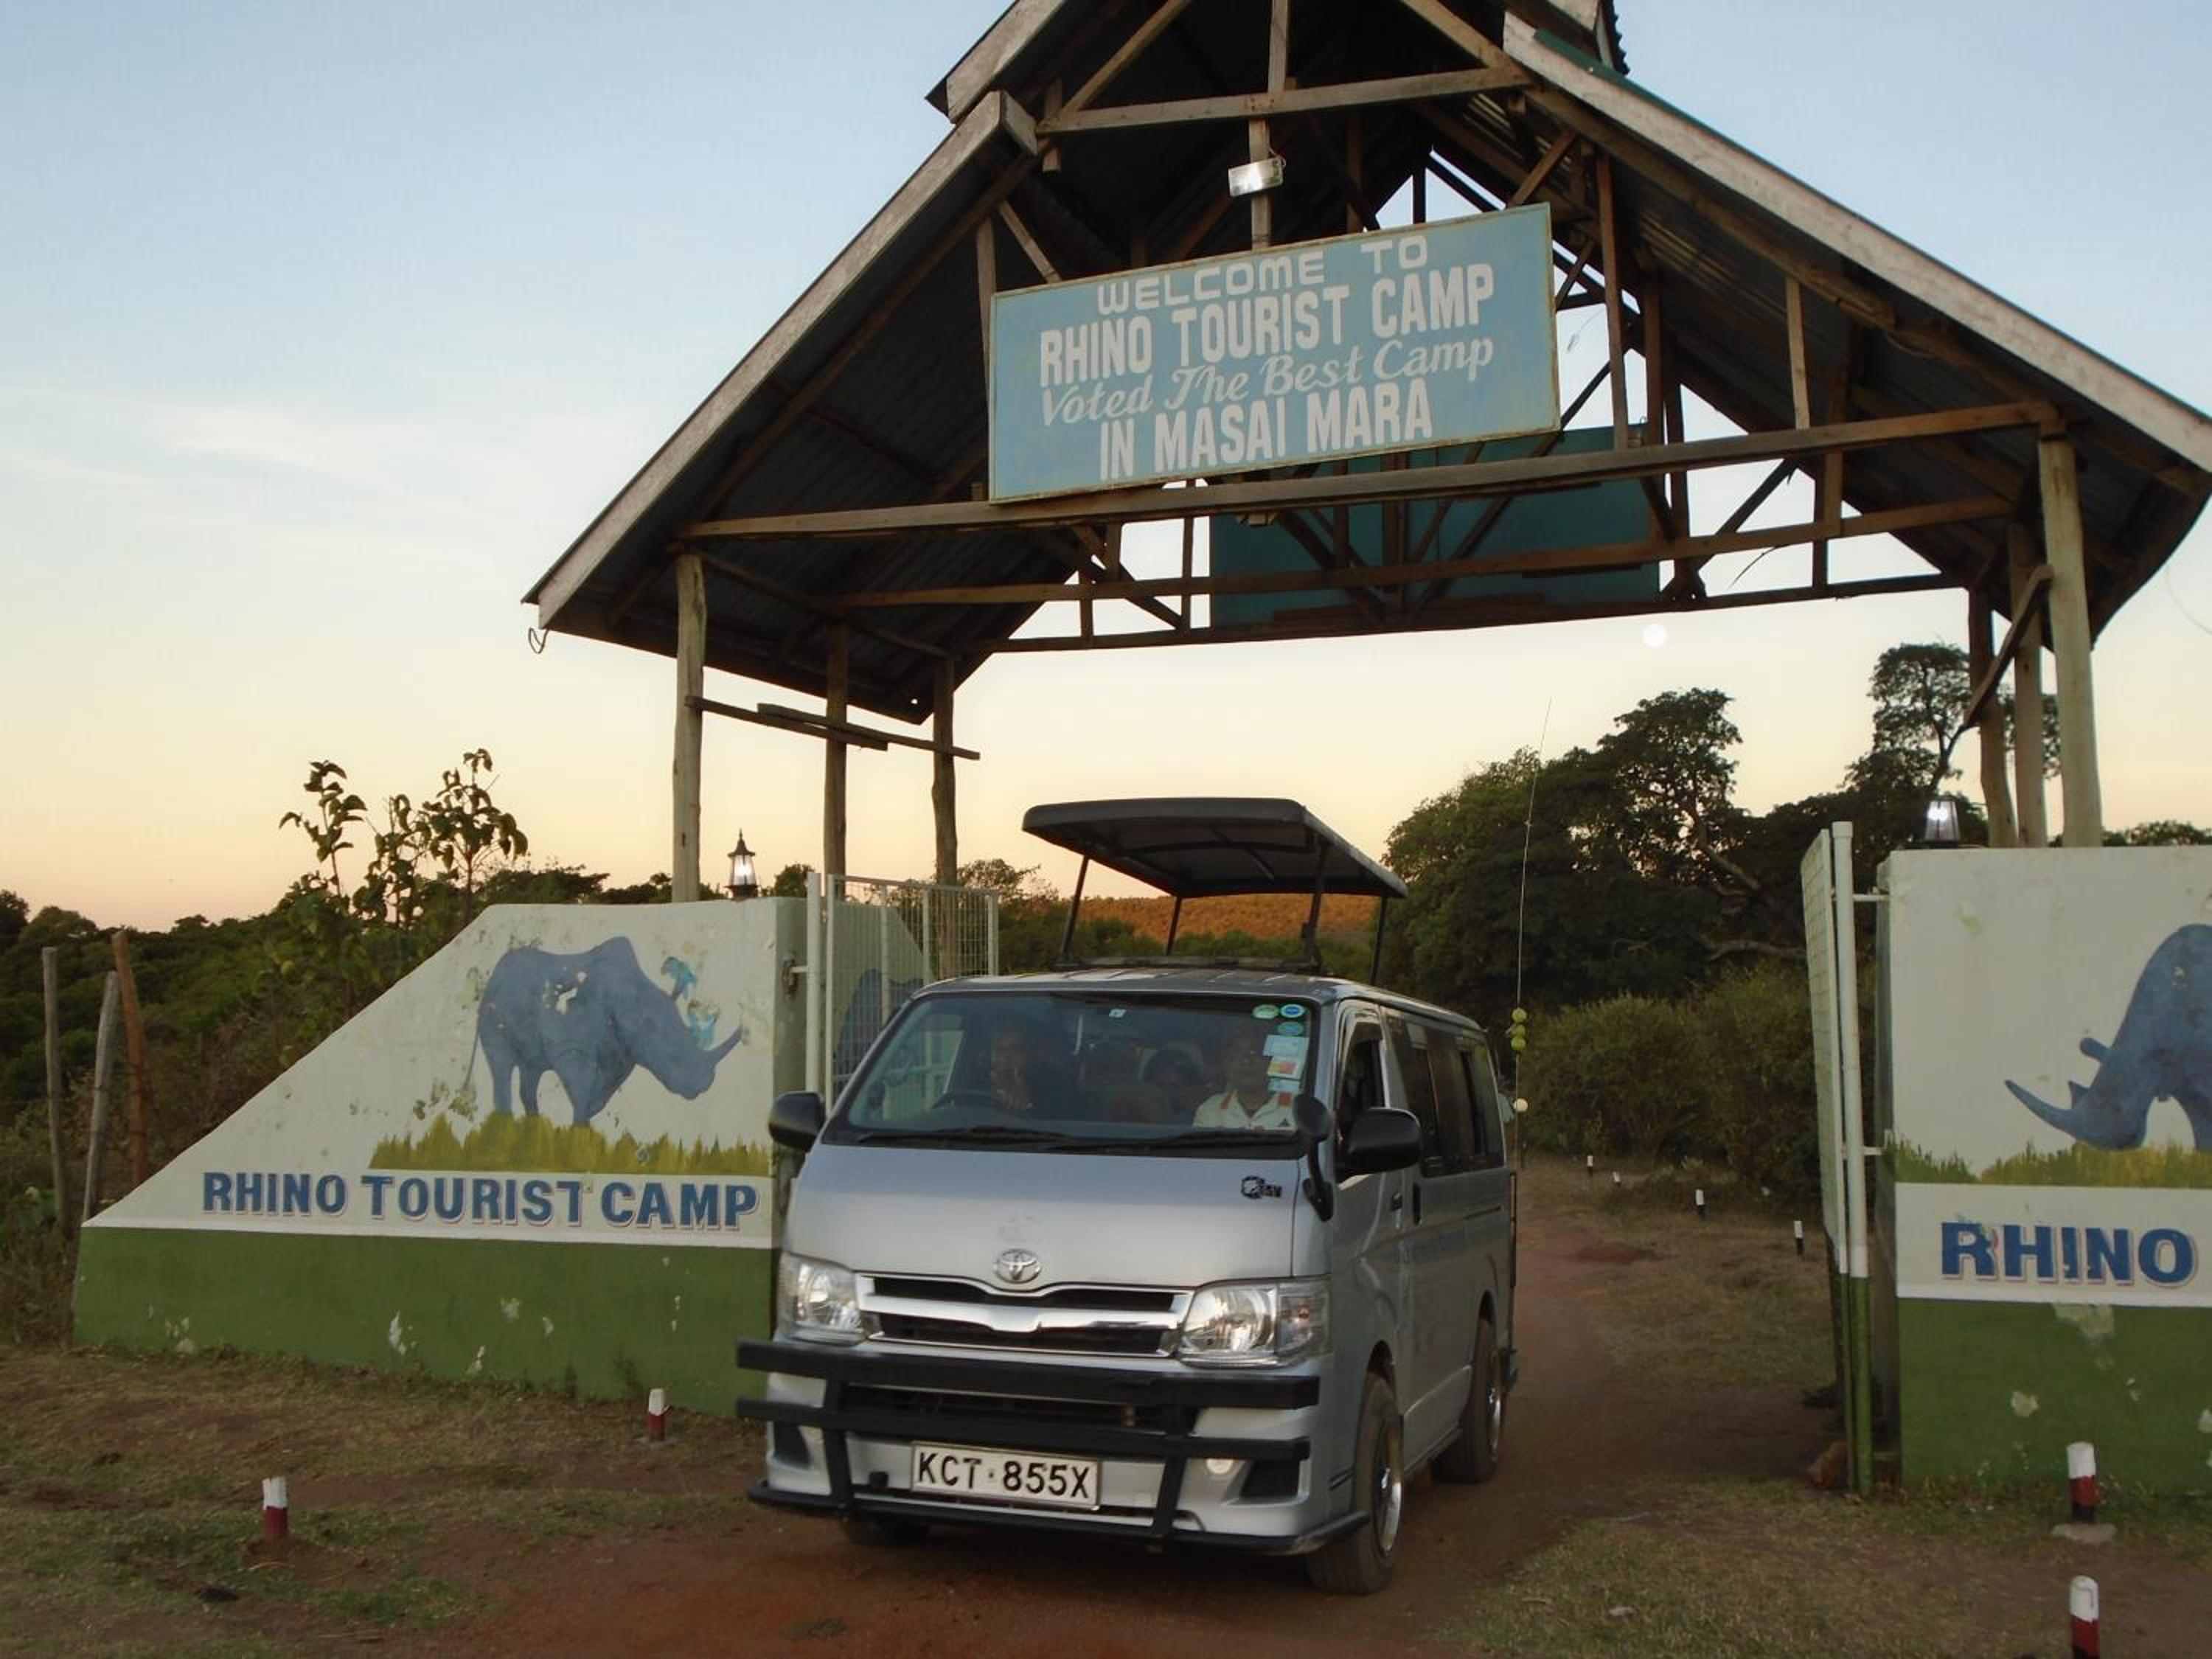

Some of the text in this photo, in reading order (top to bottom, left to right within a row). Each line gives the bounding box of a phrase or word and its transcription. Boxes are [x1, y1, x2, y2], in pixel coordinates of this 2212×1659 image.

[1098, 235, 1428, 315] WELCOME TO
[1040, 264, 1495, 388] RHINO TOURIST CAMP
[1041, 338, 1494, 427] Voted The Best Camp
[1100, 378, 1433, 481] IN MASAI MARA
[202, 1172, 759, 1231] RHINO TOURIST CAMP
[1941, 1221, 2198, 1287] RHINO
